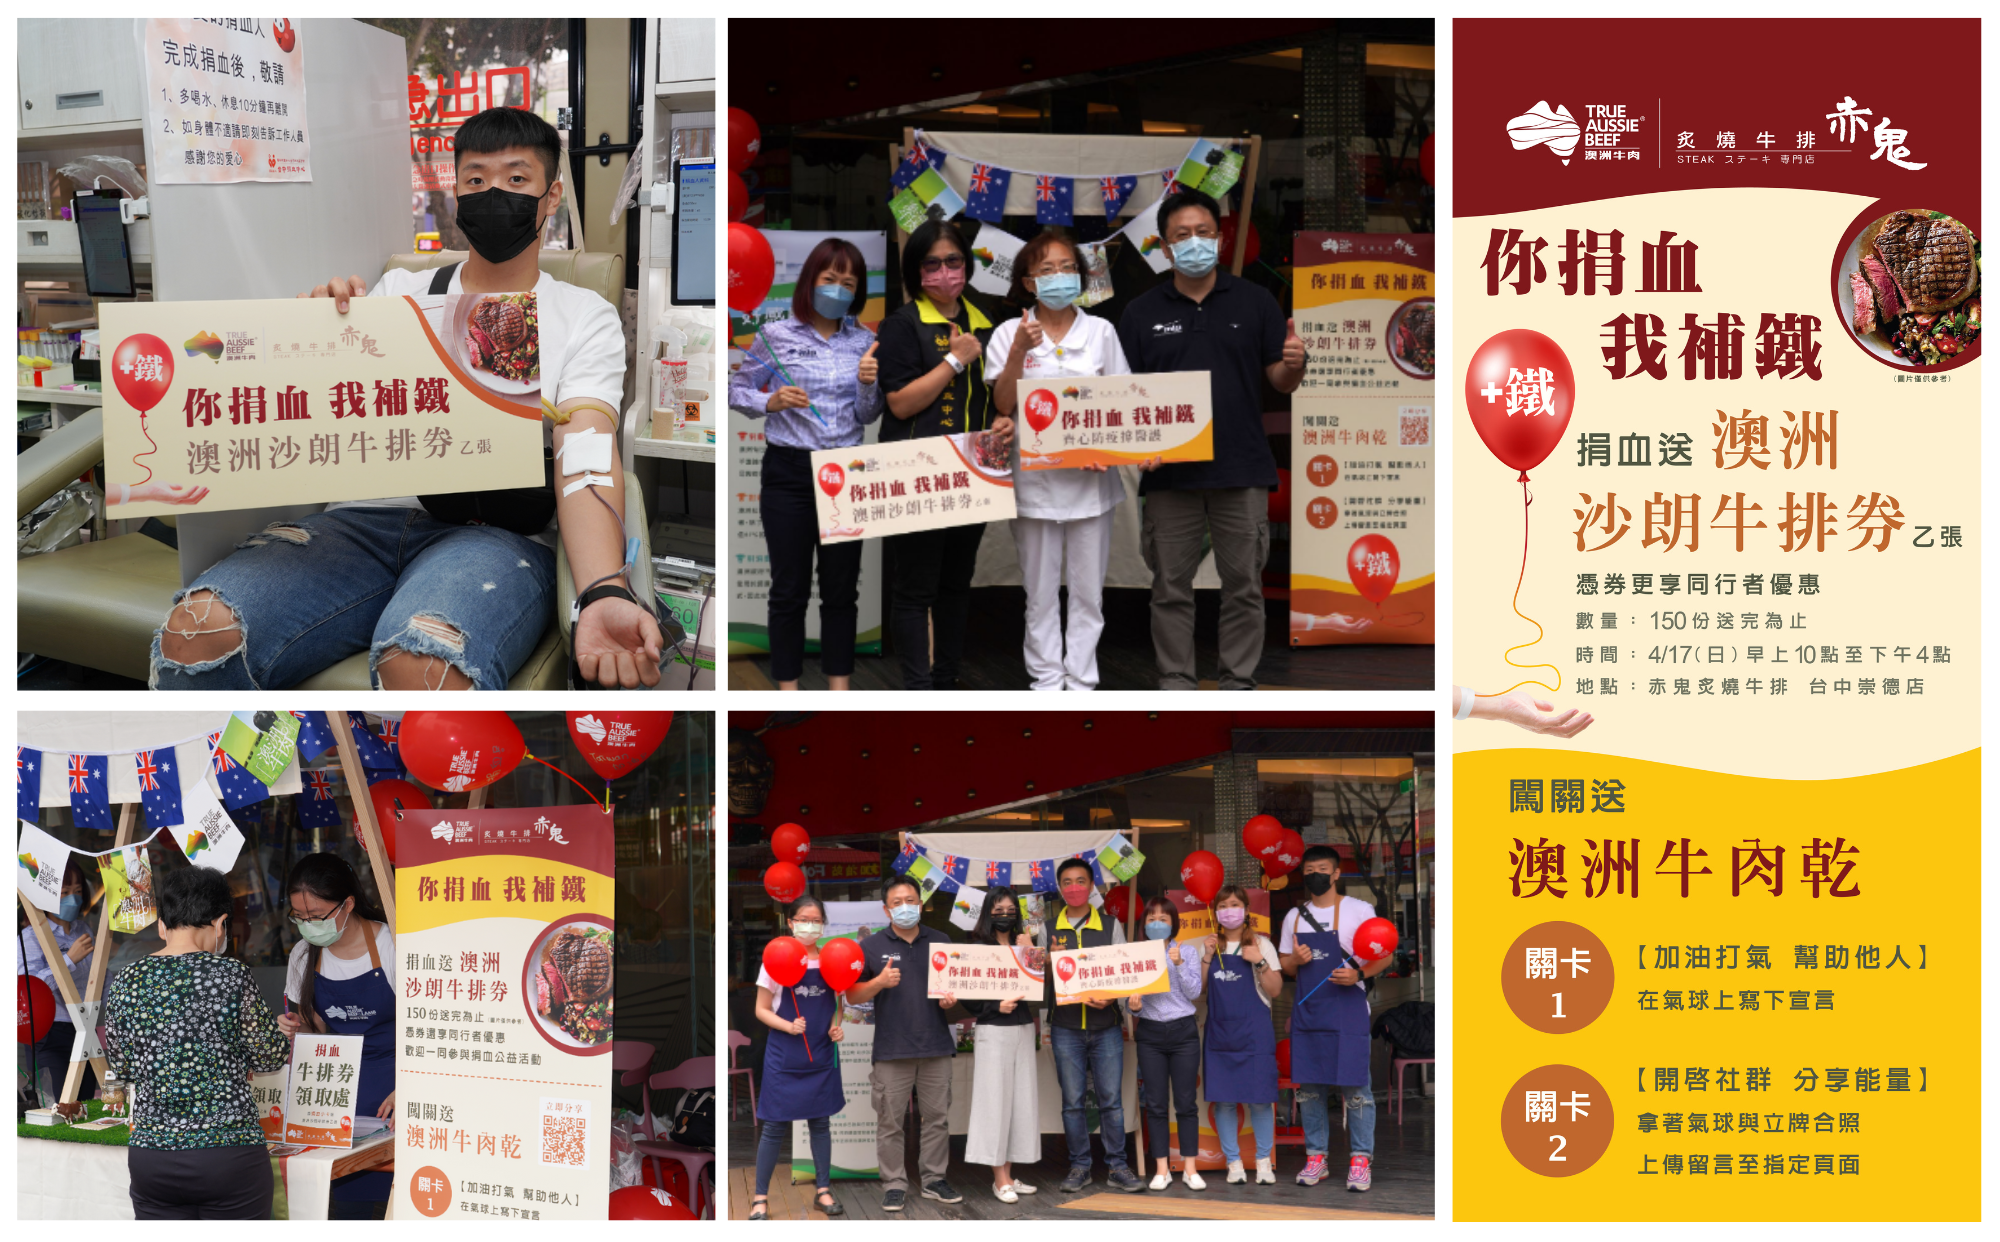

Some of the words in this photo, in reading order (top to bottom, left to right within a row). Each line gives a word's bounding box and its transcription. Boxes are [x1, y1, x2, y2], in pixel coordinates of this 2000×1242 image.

[1585, 104, 1627, 119] TRUE
[1585, 133, 1622, 148] BEEF
[1676, 130, 1817, 149] 炙燒牛排
[1825, 95, 1928, 171] 赤鬼
[185, 149, 243, 167] 感謝您的愛心
[1584, 150, 1641, 161] 澳洲牛肉
[1677, 154, 1715, 165] STEAK
[1724, 154, 1772, 165] ステーキ
[1480, 227, 1703, 297] 你捐血
[1311, 272, 1366, 291] 你捐血
[1373, 272, 1427, 292] 我補鐵
[226, 331, 248, 339] TRUE
[273, 341, 336, 352] 炙燒牛排
[226, 346, 245, 354] BEEF
[1599, 312, 1824, 382] 我補鐵
[182, 383, 312, 428] 你捐血
[328, 376, 451, 420] 我補鐵
[1061, 408, 1124, 431] 你捐血
[1132, 403, 1195, 426] 我補鐵
[186, 425, 454, 476] 澳洲沙朗牛排券
[460, 438, 492, 455] 乙張
[1576, 431, 1694, 468] 捐血送
[1711, 408, 1839, 471] 澳洲
[849, 479, 907, 503] 你捐血
[914, 470, 970, 494] 我補鐵
[1319, 516, 1326, 526] 2
[1572, 491, 1906, 553] 沙朗牛排券
[1911, 525, 1964, 548] 乙張
[1576, 573, 1821, 597] 憑券更享同行者優惠
[1647, 677, 1789, 696] 赤鬼炙燒牛排
[1808, 677, 1925, 696] 台中崇德店
[608, 728, 638, 737] AUSSIE
[610, 721, 633, 730] TRUE
[607, 734, 627, 742] BEEF
[1509, 778, 1627, 814] 闖關送
[200, 808, 216, 826] TRUE
[204, 810, 223, 834] AUSSIE
[208, 823, 221, 840] BEEF
[41, 861, 56, 874] TRUE
[1507, 836, 1862, 900] 澳洲牛肉乾
[417, 876, 492, 903] 你捐血
[503, 875, 587, 904] 我補鐵
[405, 952, 453, 972] 捐血送
[460, 950, 500, 974] 澳洲
[1078, 964, 1116, 980] 你捐血
[1524, 946, 1592, 981] 關卡
[405, 976, 509, 1003] 沙朗牛排券
[1637, 989, 1836, 1012] 在氣球上寫下宣言
[406, 1006, 485, 1024] 150份送完為止
[1550, 992, 1567, 1019] 1
[315, 1043, 340, 1058] 捐血
[296, 1061, 355, 1084] 牛排券
[295, 1085, 351, 1109] 領取處
[545, 1101, 584, 1115] 立即分享
[1524, 1089, 1592, 1124] 關卡
[406, 1101, 455, 1124] 闖關送
[1636, 1112, 1862, 1134] 拿著氣球與立牌合照
[406, 1123, 522, 1160] 澳洲牛肉乾
[1547, 1134, 1568, 1163] 2
[1636, 1153, 1861, 1176] 上傳留言至指定頁面
[418, 1175, 444, 1195] 關卡
[427, 1197, 434, 1211] 1
